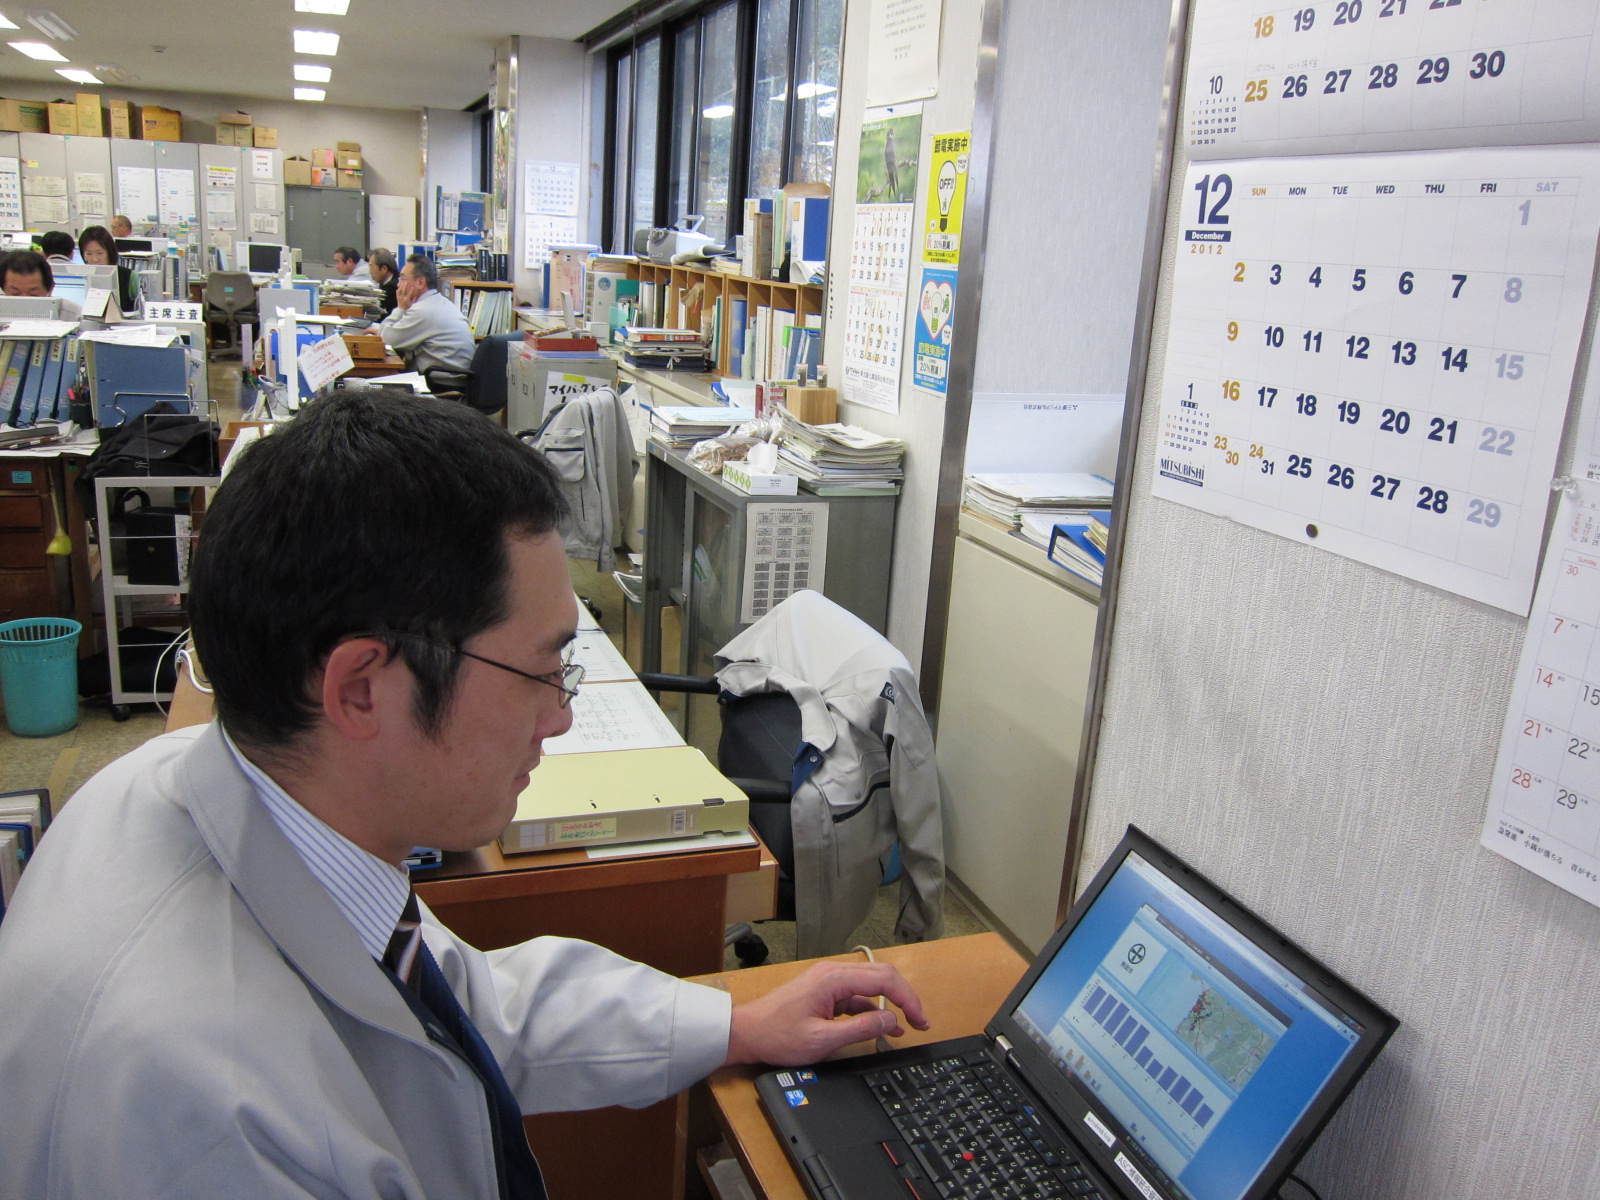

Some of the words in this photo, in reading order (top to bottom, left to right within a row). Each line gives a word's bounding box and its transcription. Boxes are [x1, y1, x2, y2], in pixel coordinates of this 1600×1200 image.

[1255, 16, 1274, 38] 18
[1294, 8, 1315, 32] 19
[1333, 0, 1362, 25] 20
[1379, 0, 1406, 18] 21
[1210, 76, 1222, 94] 10
[1245, 80, 1267, 102] 25
[1283, 75, 1307, 98] 26
[1323, 69, 1351, 94] 27
[1368, 64, 1398, 89] 28
[1417, 57, 1449, 84] 29
[1470, 51, 1505, 79] 30
[1195, 174, 1232, 224] 12
[1289, 187, 1306, 195] MON
[1333, 186, 1348, 194] TUE
[1376, 185, 1395, 194] WED
[1425, 185, 1445, 193] THU
[1481, 183, 1497, 192] FRI
[1536, 182, 1559, 192] SAT
[1519, 200, 1531, 225] 1
[1191, 244, 1222, 254] 2012
[1192, 232, 1224, 241] December
[1234, 262, 1245, 281] 2
[1270, 264, 1281, 285] 3
[1309, 267, 1321, 287] 4
[1352, 269, 1366, 291] 5
[1399, 271, 1414, 295] 6
[1452, 274, 1467, 298] 7
[1504, 278, 1522, 303] 8
[149, 306, 198, 320] 主席主査
[1228, 322, 1238, 341] 9
[1265, 326, 1284, 347] 10
[1304, 331, 1322, 352] 11
[1346, 336, 1370, 359] 12
[1392, 341, 1416, 365] 13
[1442, 347, 1468, 372] 14
[1496, 354, 1524, 380] 15
[1188, 383, 1193, 399] 1
[1223, 380, 1240, 400] 16
[1258, 387, 1277, 407] 17
[1296, 393, 1317, 416] 18
[1338, 401, 1360, 424] 19
[1380, 409, 1410, 434] 20
[1428, 418, 1457, 444] 21
[1479, 427, 1515, 456] 22
[1160, 456, 1205, 480] MITSUBISHI
[1225, 450, 1239, 466] 30
[1261, 460, 1274, 475] 31
[1214, 435, 1228, 450] 23
[1249, 444, 1264, 459] 24
[1287, 455, 1312, 478] 25
[1328, 464, 1354, 489] 26
[1371, 475, 1400, 500] 27
[1417, 487, 1448, 514] 28
[1467, 499, 1501, 527] 29
[1566, 565, 1578, 575] 30
[1578, 556, 1597, 567] Sunday
[1554, 618, 1564, 633] 7
[1537, 668, 1552, 687] 14
[1583, 686, 1600, 706] 15
[1524, 720, 1540, 738] 21
[1568, 738, 1589, 759] 22
[1512, 769, 1531, 788] 28
[1557, 789, 1577, 809] 29
